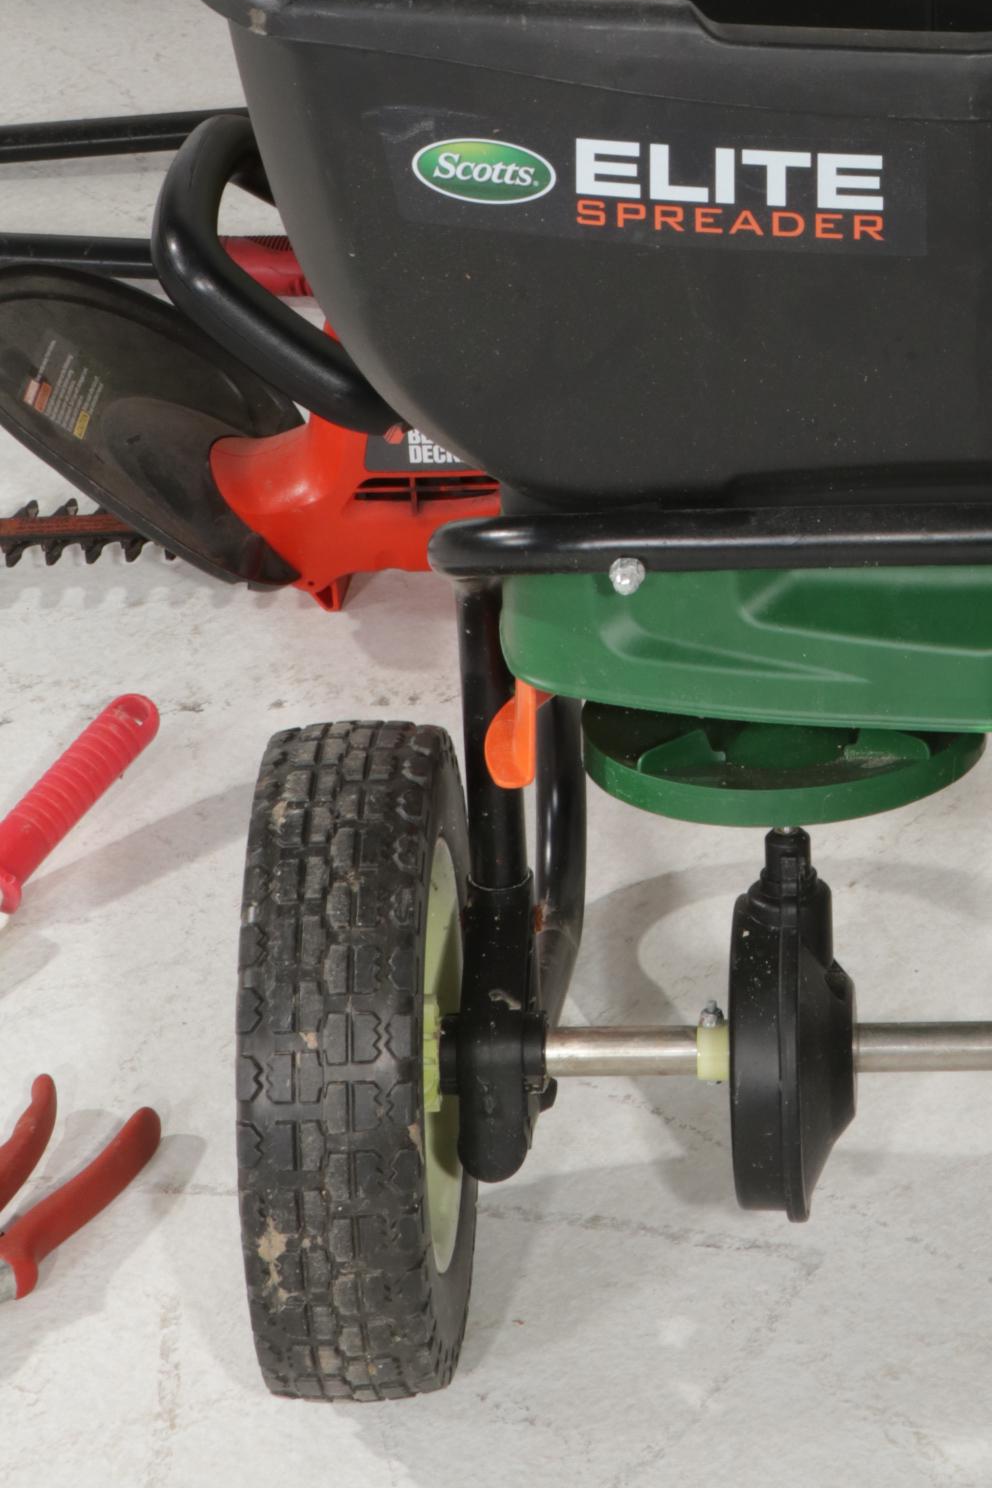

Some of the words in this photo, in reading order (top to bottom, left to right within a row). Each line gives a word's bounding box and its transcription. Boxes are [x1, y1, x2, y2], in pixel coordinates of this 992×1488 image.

[433, 152, 535, 186] Scotts
[576, 138, 884, 211] ELITE
[576, 199, 885, 241] SPREADER
